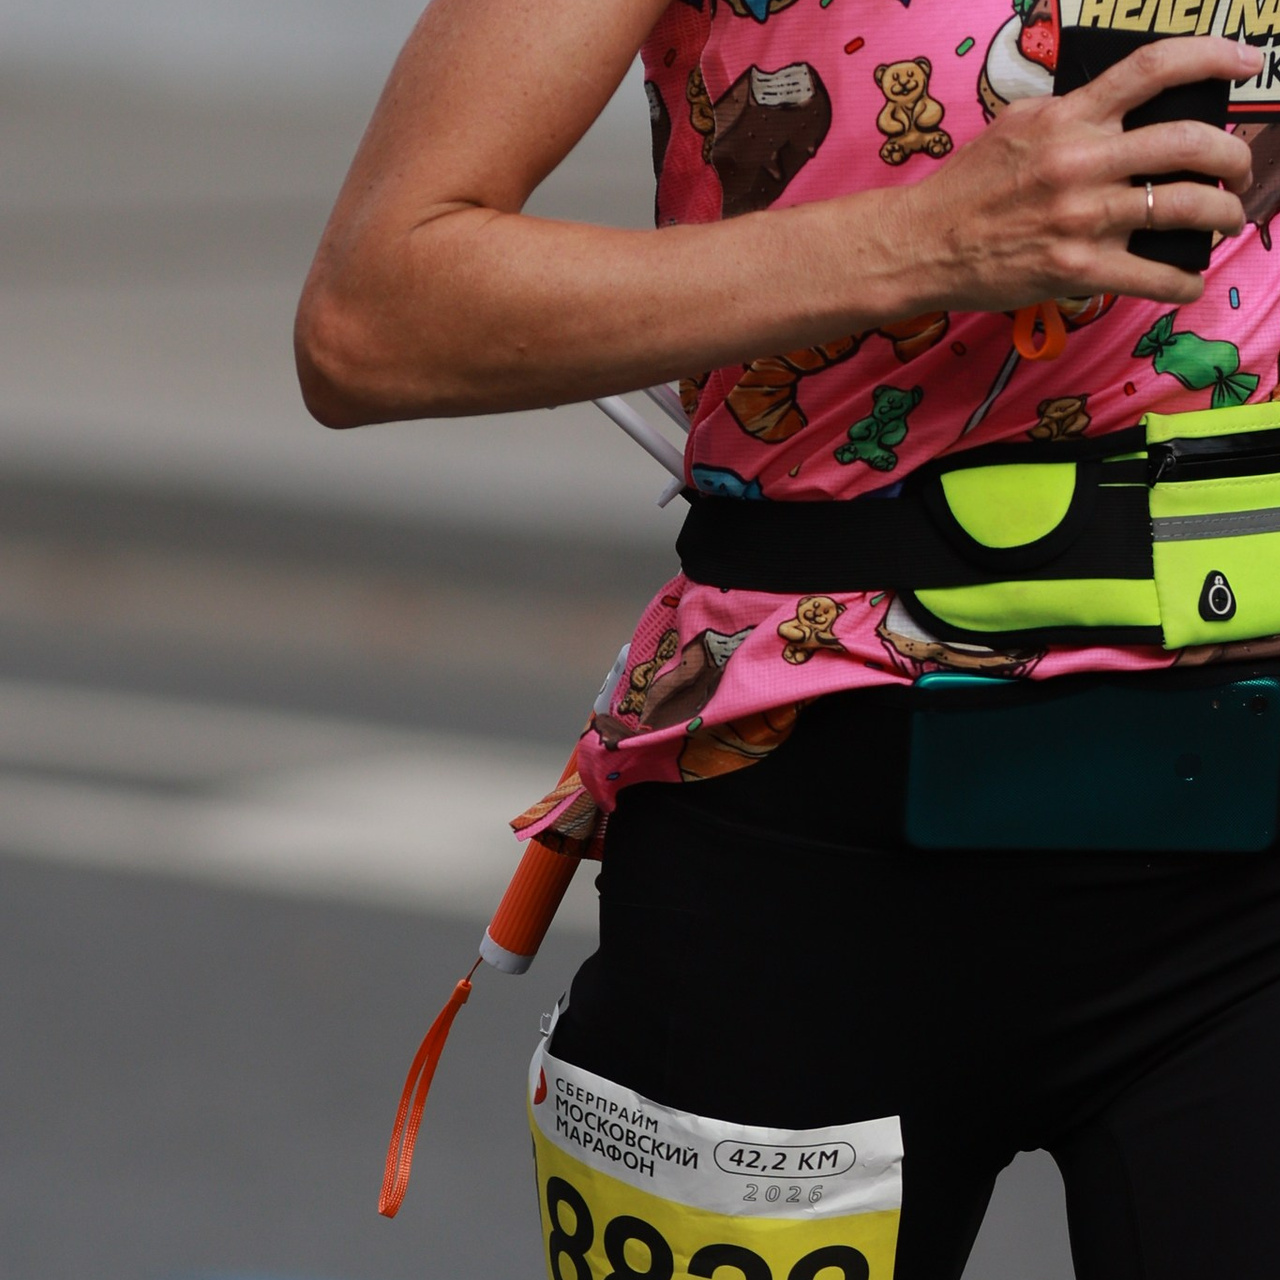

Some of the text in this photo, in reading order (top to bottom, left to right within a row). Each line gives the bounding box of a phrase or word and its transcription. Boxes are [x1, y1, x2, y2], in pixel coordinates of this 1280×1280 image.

[555, 1077, 659, 1134] СБЕРПРАЙМ
[555, 1094, 699, 1170] МОСКОВСКИЙ
[555, 1115, 655, 1178] МАРАФОН
[729, 1149, 787, 1172] 42,2
[743, 1183, 823, 1204] 2026
